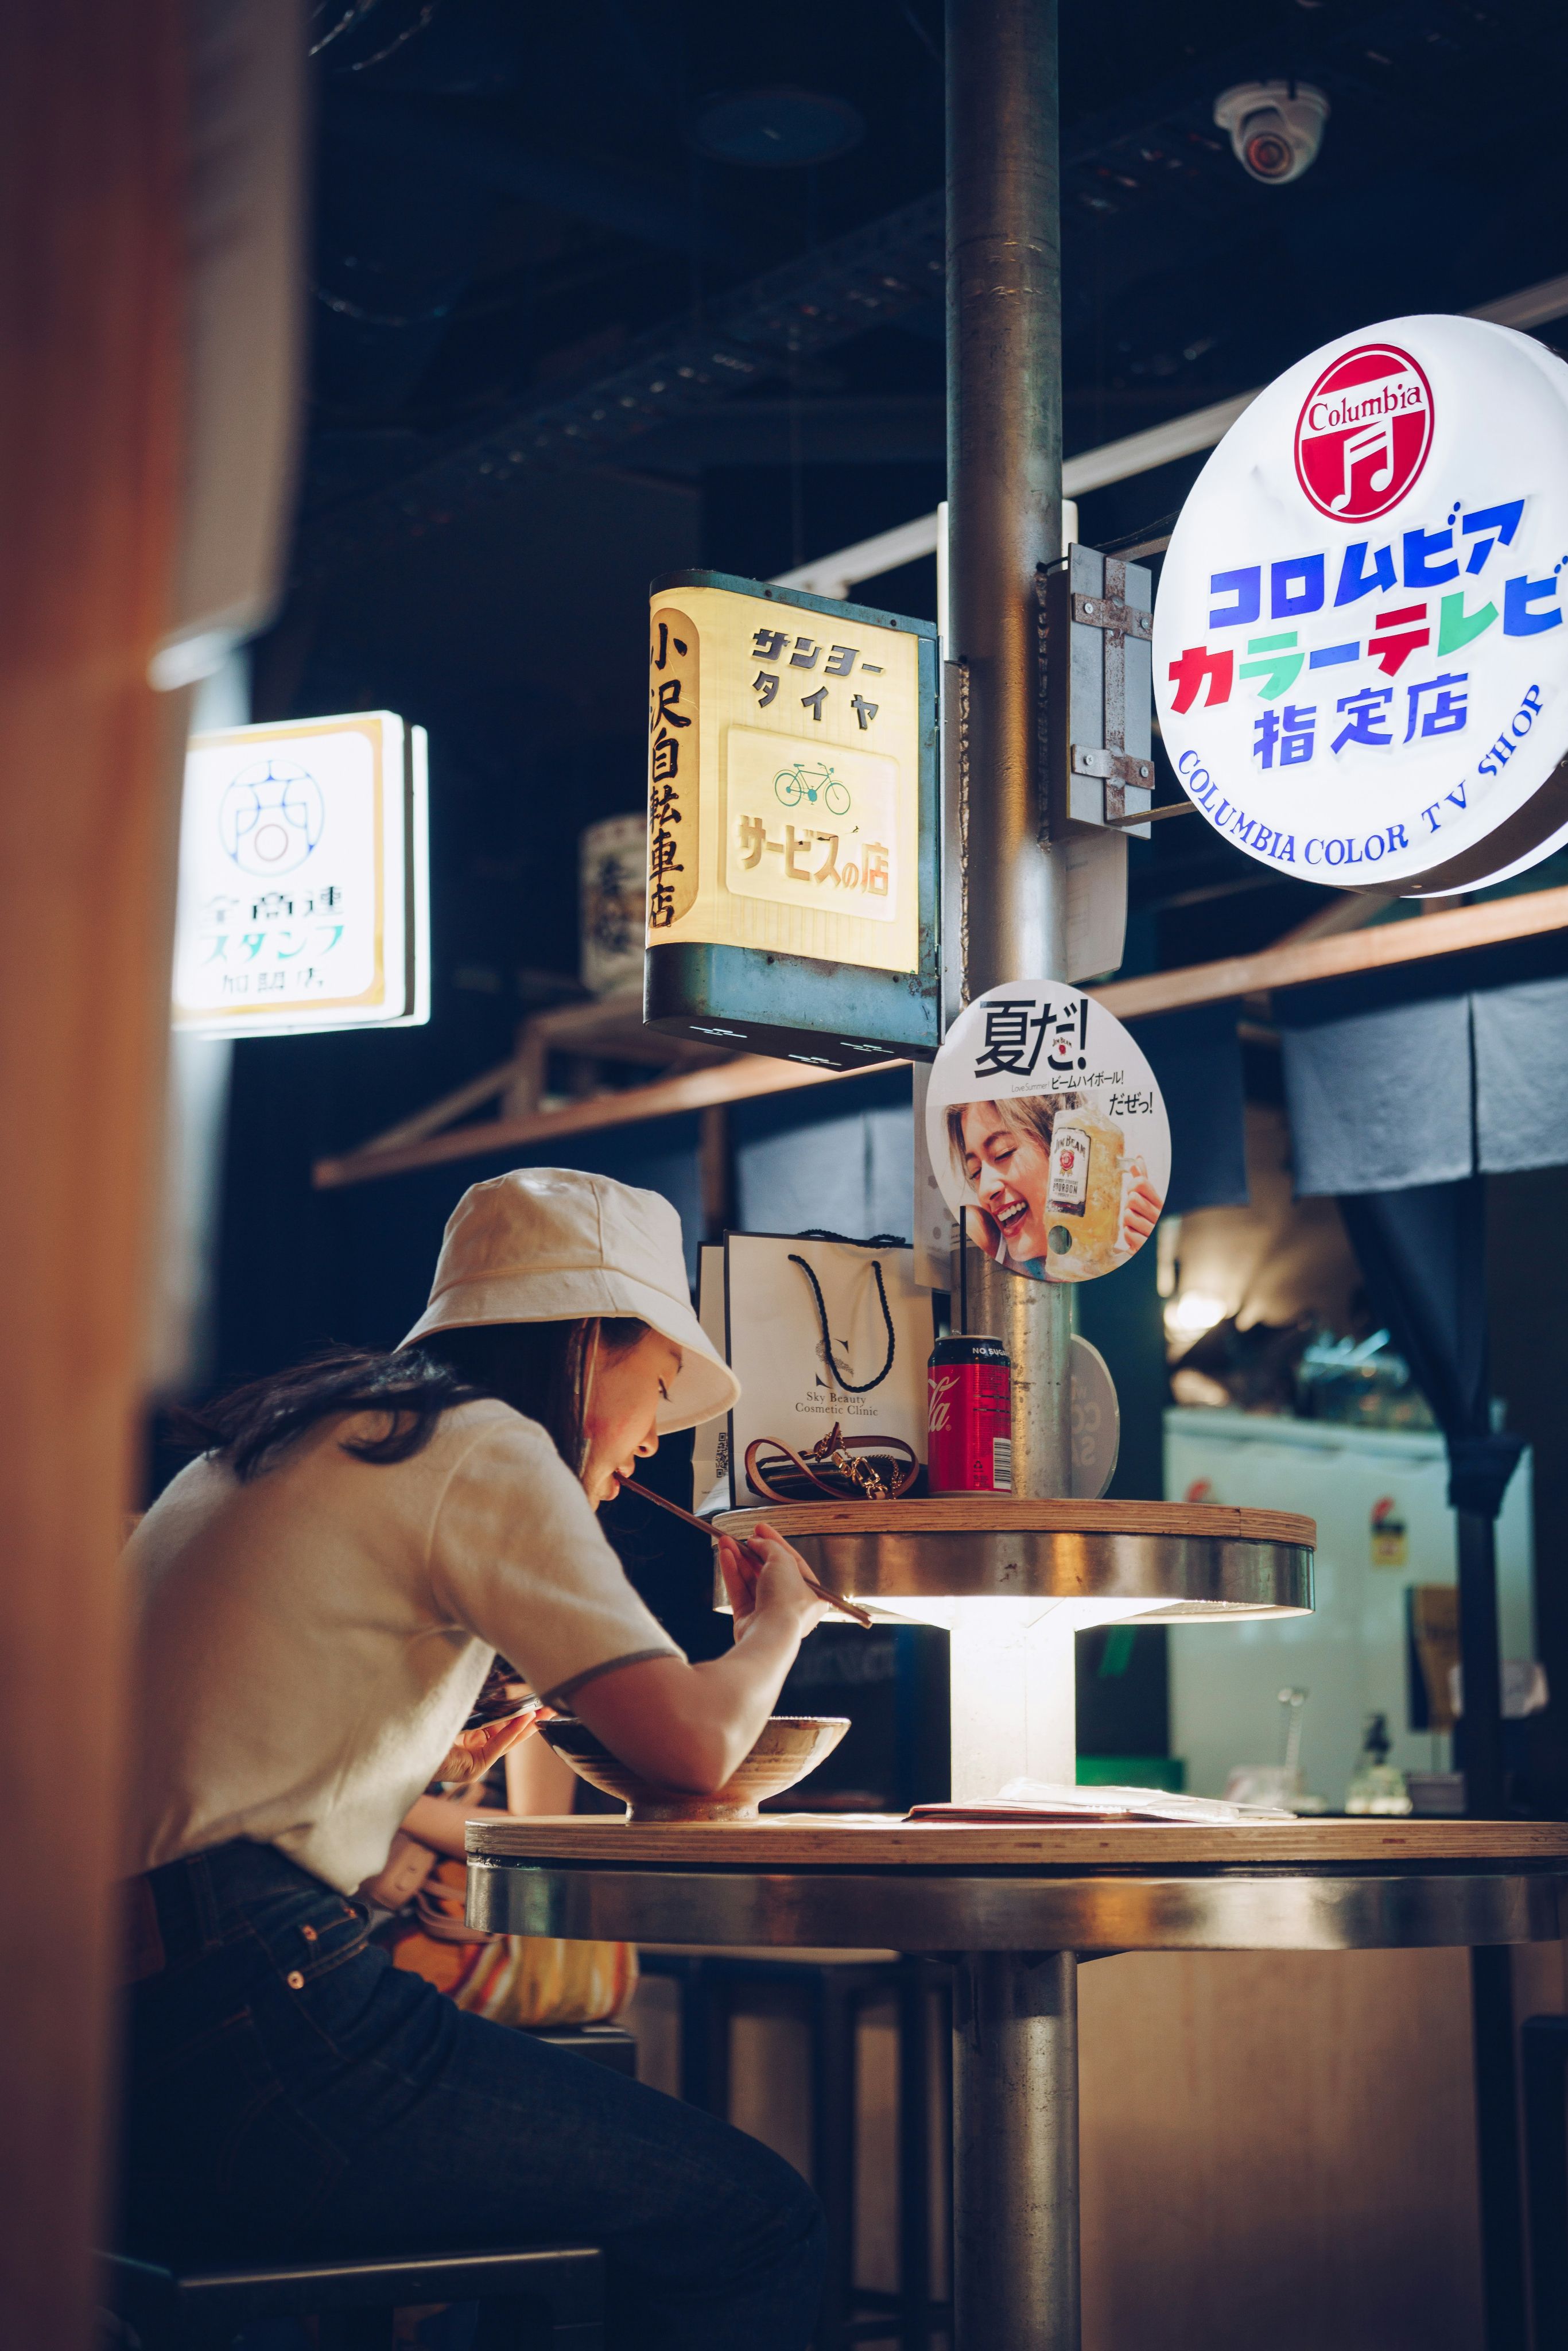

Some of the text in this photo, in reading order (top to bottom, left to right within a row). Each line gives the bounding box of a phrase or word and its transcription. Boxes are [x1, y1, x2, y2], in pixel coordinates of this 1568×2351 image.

[1309, 383, 1422, 431] Columbia
[1209, 498, 1525, 629] コロムビア
[751, 628, 885, 677] サンヨー
[1169, 554, 1568, 715] カラーテレビ
[751, 670, 879, 731] タイヤ
[1253, 672, 1469, 769] 指定店
[649, 622, 692, 928] 小沢自転車店
[1178, 750, 1295, 863] COLUMBIA
[1304, 824, 1409, 866] COLOR
[1478, 684, 1543, 776] SHOP
[739, 814, 889, 897] サービスの店
[973, 998, 1088, 1078] 夏だ!
[1051, 1070, 1124, 1090] ビームハイボール!
[1109, 1092, 1152, 1116] だぜっ!
[988, 1348, 1008, 1356] SUGA
[795, 1402, 879, 1416] Cosmetic Clinic
[806, 1391, 867, 1405] Sky Beauty
